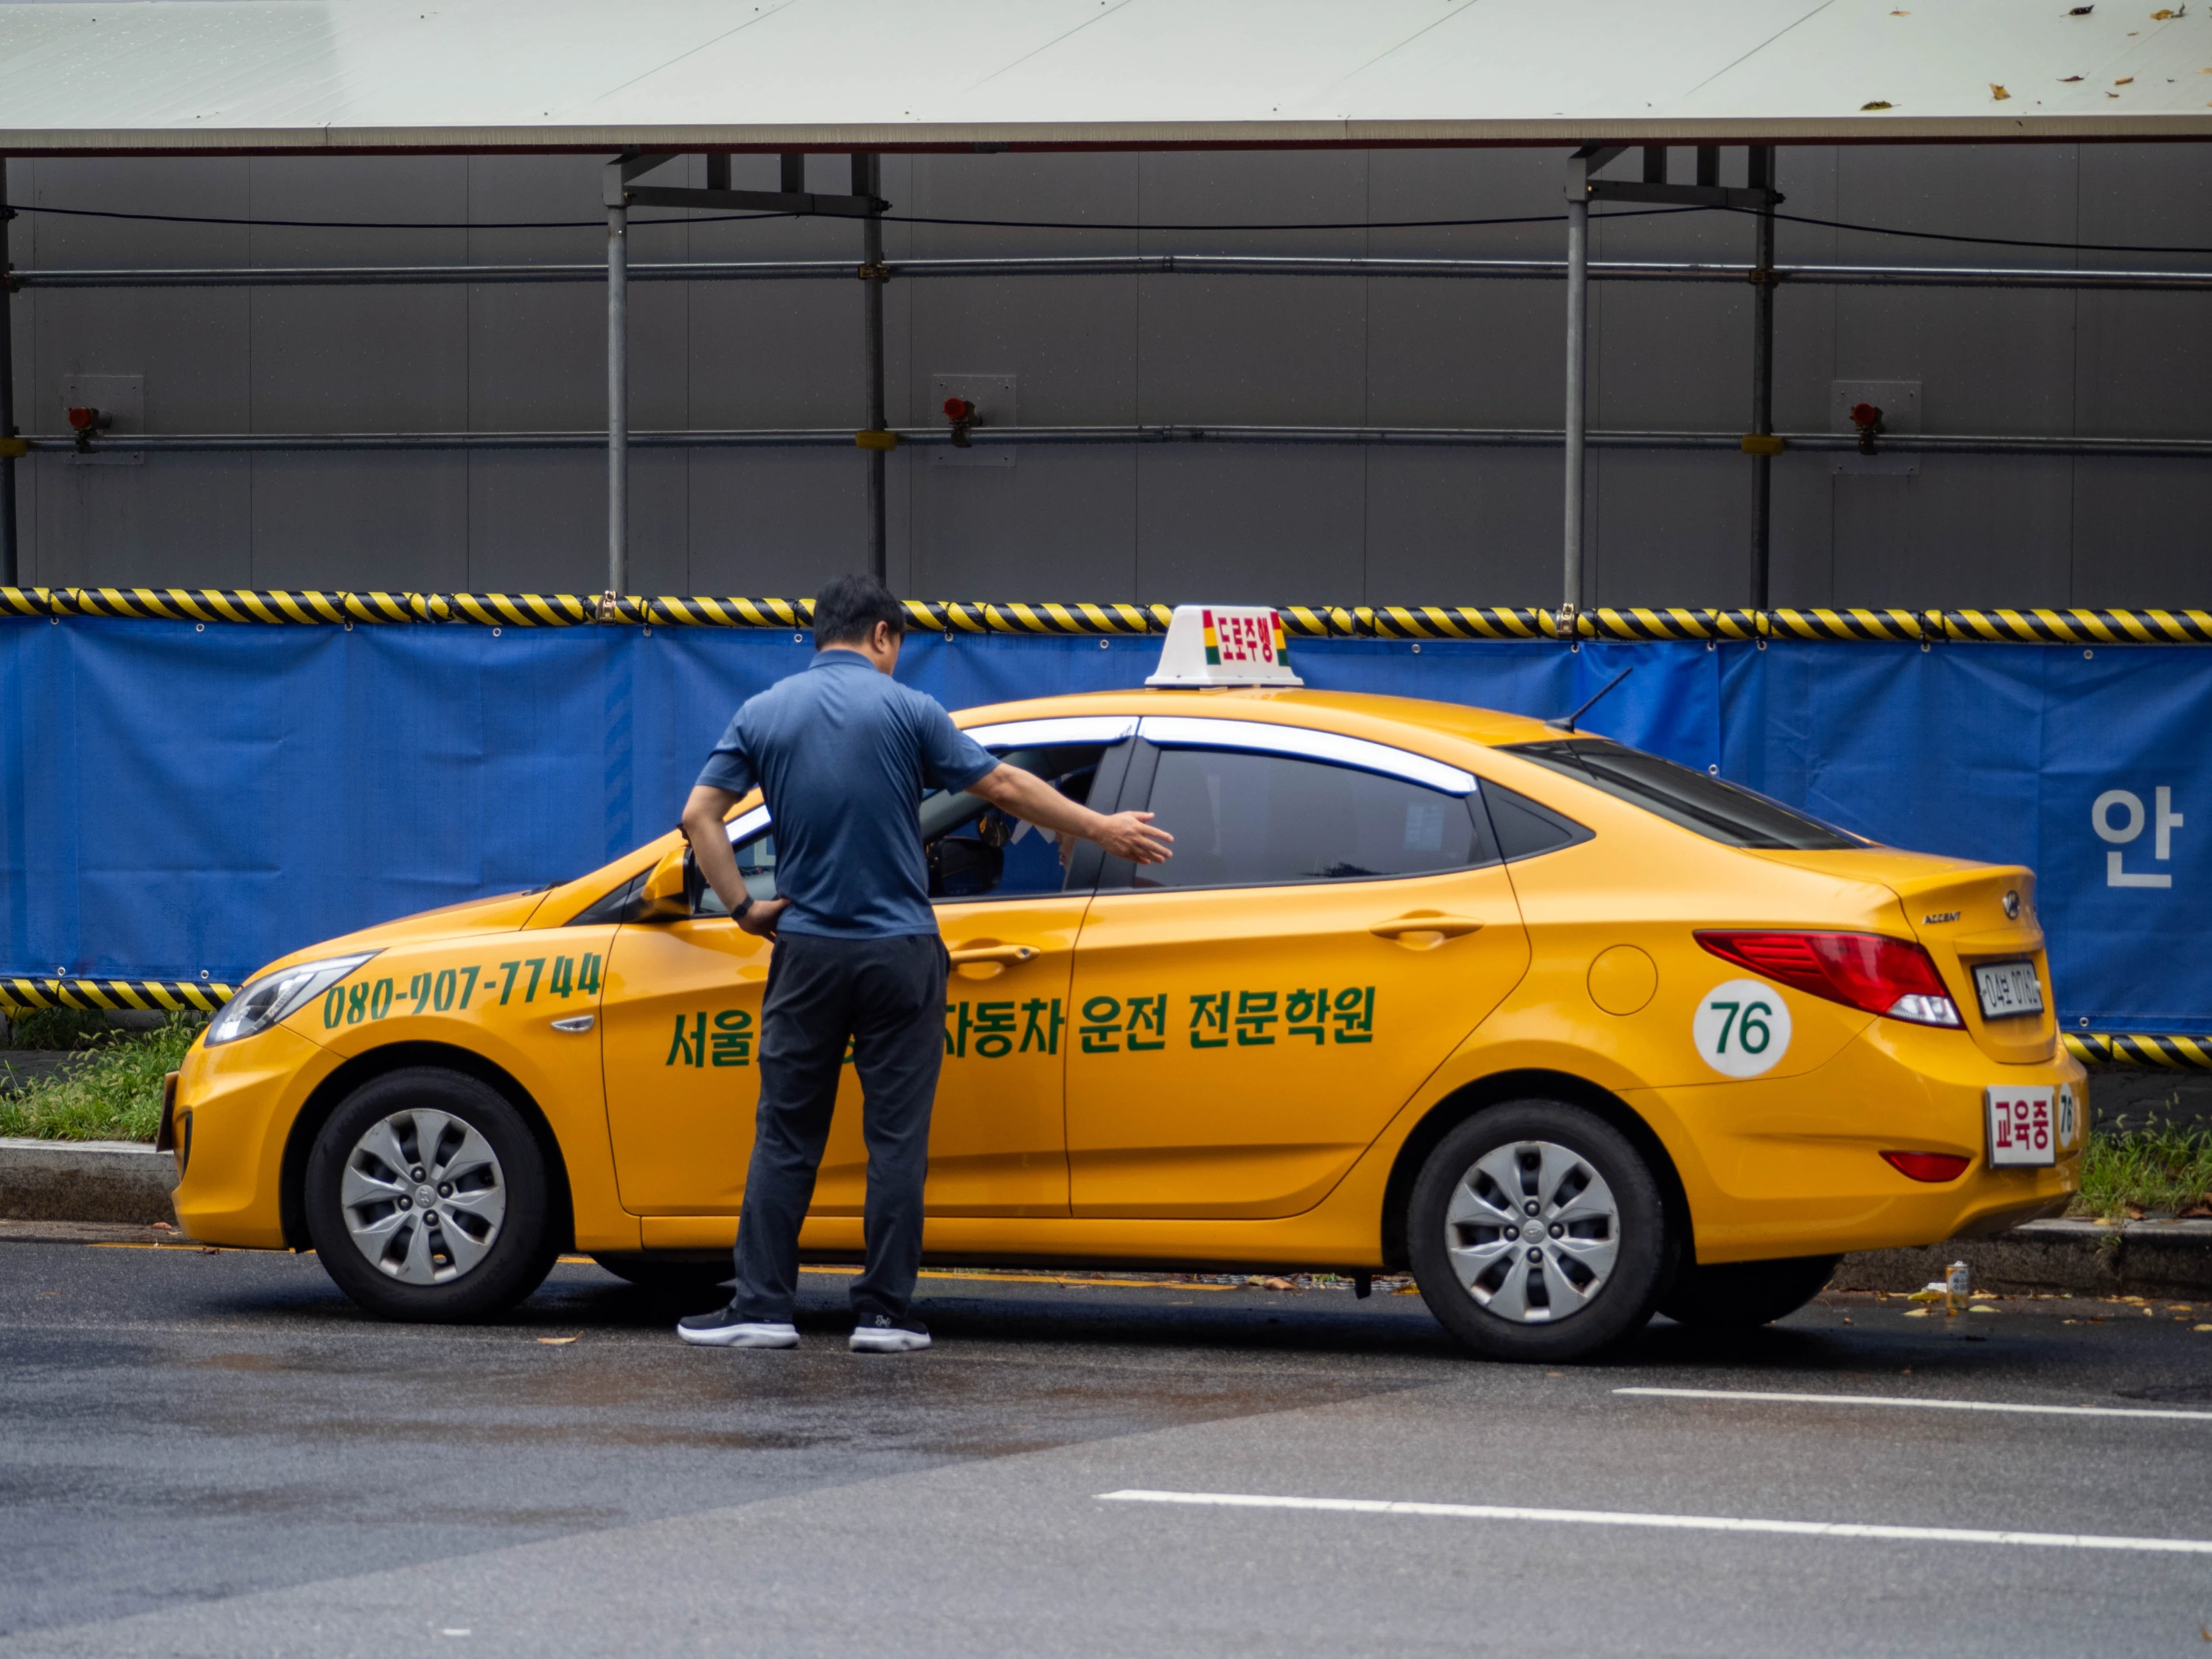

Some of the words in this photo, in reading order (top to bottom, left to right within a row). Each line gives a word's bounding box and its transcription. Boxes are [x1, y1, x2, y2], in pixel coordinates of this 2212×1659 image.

[1218, 617, 1273, 663] 도로주행
[2092, 786, 2183, 888] 안
[1921, 911, 1961, 926] ACCENT
[324, 952, 602, 1029] 080-907-7744
[1079, 993, 1168, 1054] 운전
[1189, 986, 1376, 1049] 전문학원
[1711, 1001, 1773, 1054] 76
[1995, 1099, 2048, 1150] 교육중
[2061, 1095, 2073, 1133] 76
